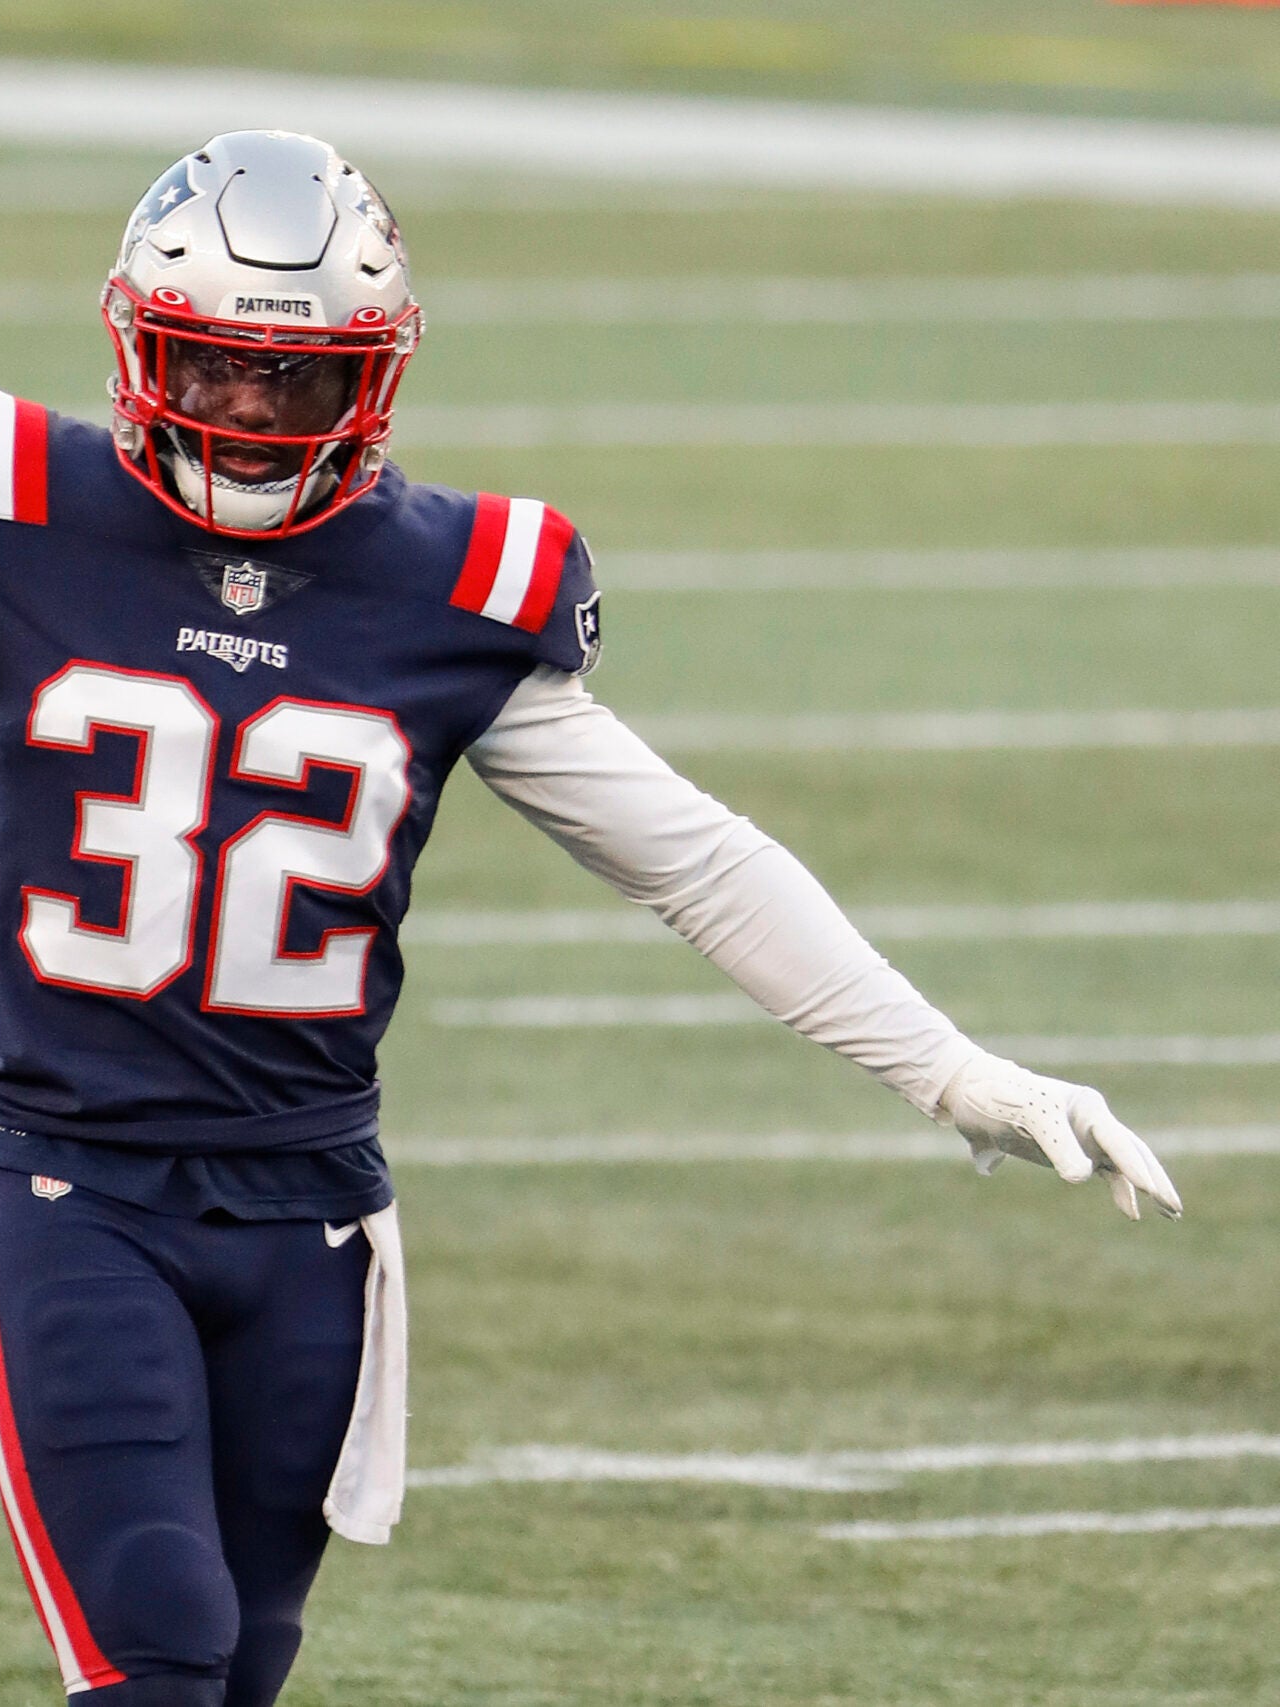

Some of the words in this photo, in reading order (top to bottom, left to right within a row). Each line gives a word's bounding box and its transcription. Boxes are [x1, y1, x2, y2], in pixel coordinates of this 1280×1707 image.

[235, 296, 312, 318] PATRIOTS
[226, 585, 255, 604] NFL
[176, 626, 288, 669] PATRIOTS
[17, 659, 413, 1020] 32
